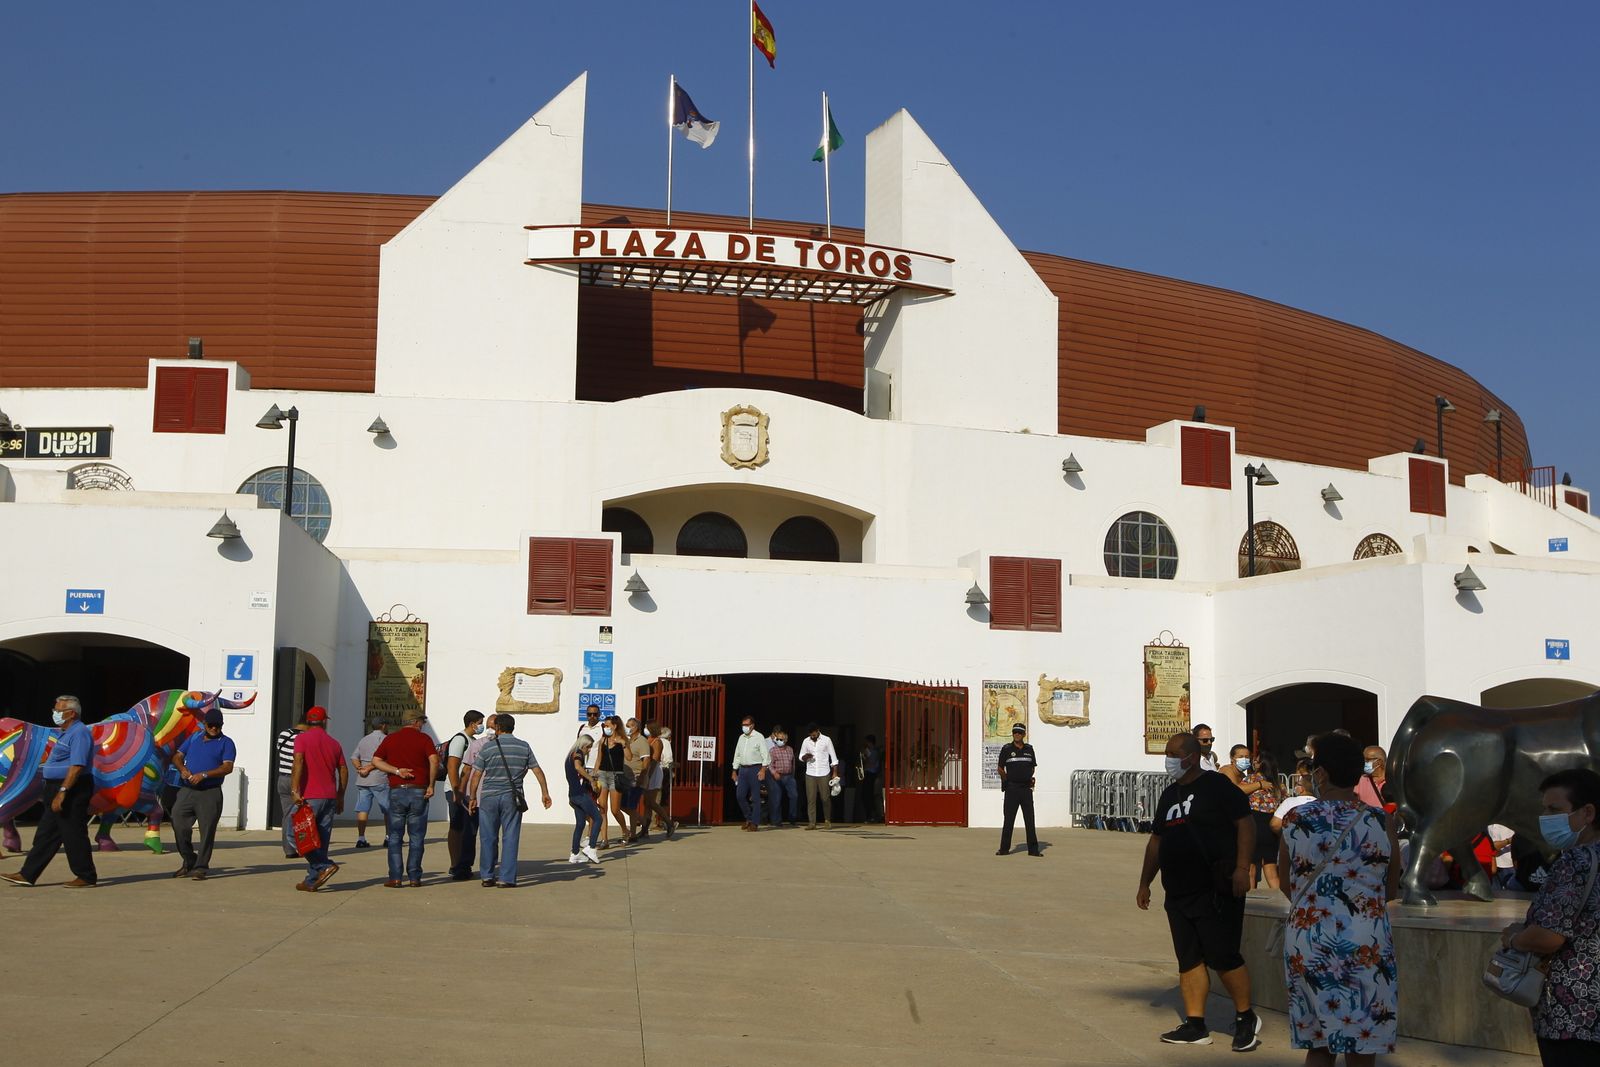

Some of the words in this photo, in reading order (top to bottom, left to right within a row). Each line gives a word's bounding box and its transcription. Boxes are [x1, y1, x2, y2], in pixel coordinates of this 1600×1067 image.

[573, 230, 706, 259] PLAZA
[727, 234, 775, 263] DE
[794, 240, 912, 280] TOROS
[39, 432, 97, 457] DUBAI
[691, 740, 714, 748] TAQULLAS
[692, 751, 712, 759] ABIETAS
